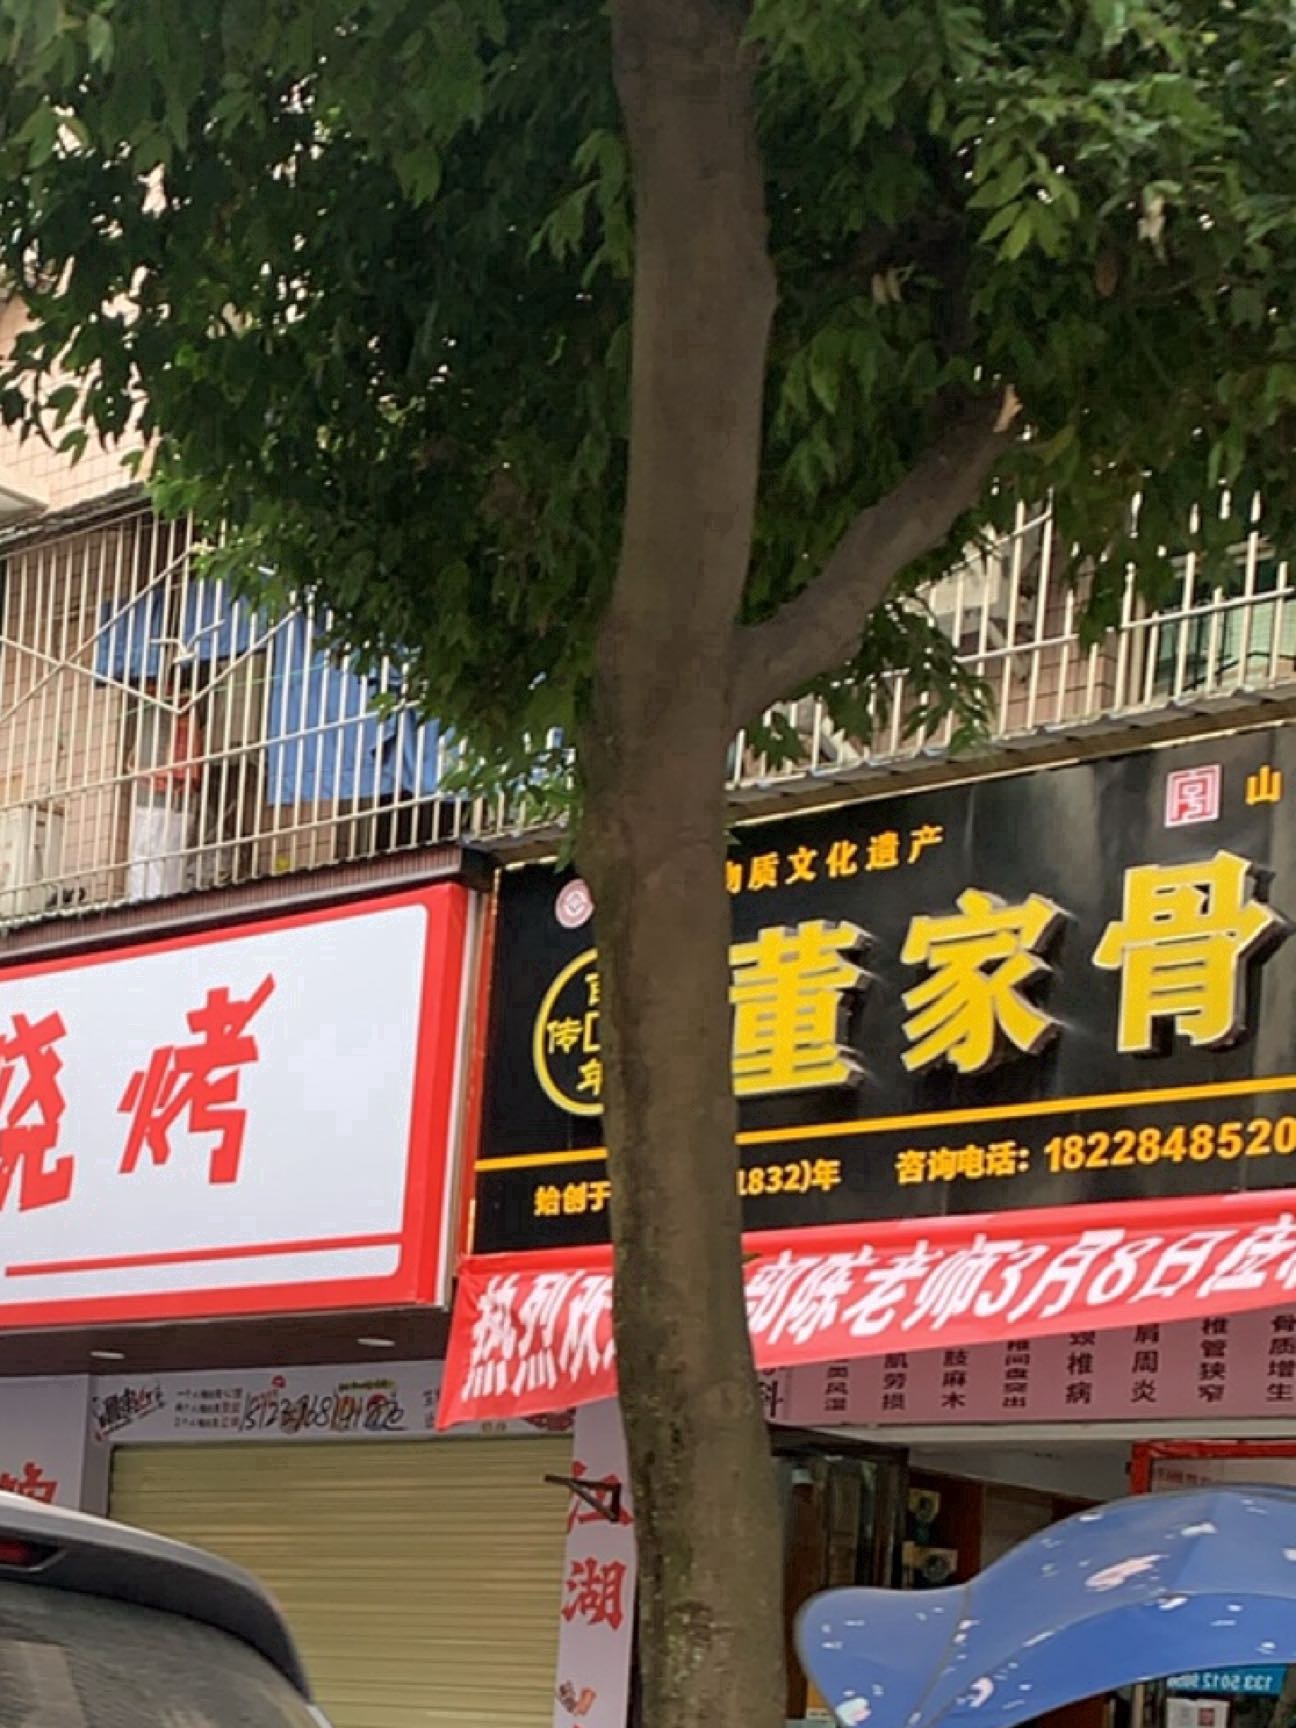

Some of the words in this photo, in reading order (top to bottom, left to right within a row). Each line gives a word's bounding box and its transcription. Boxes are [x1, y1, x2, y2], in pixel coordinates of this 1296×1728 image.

[1246, 765, 1282, 805] 山
[728, 850, 1279, 1097] 董家骨
[1044, 1118, 1296, 1174] 1822848520
